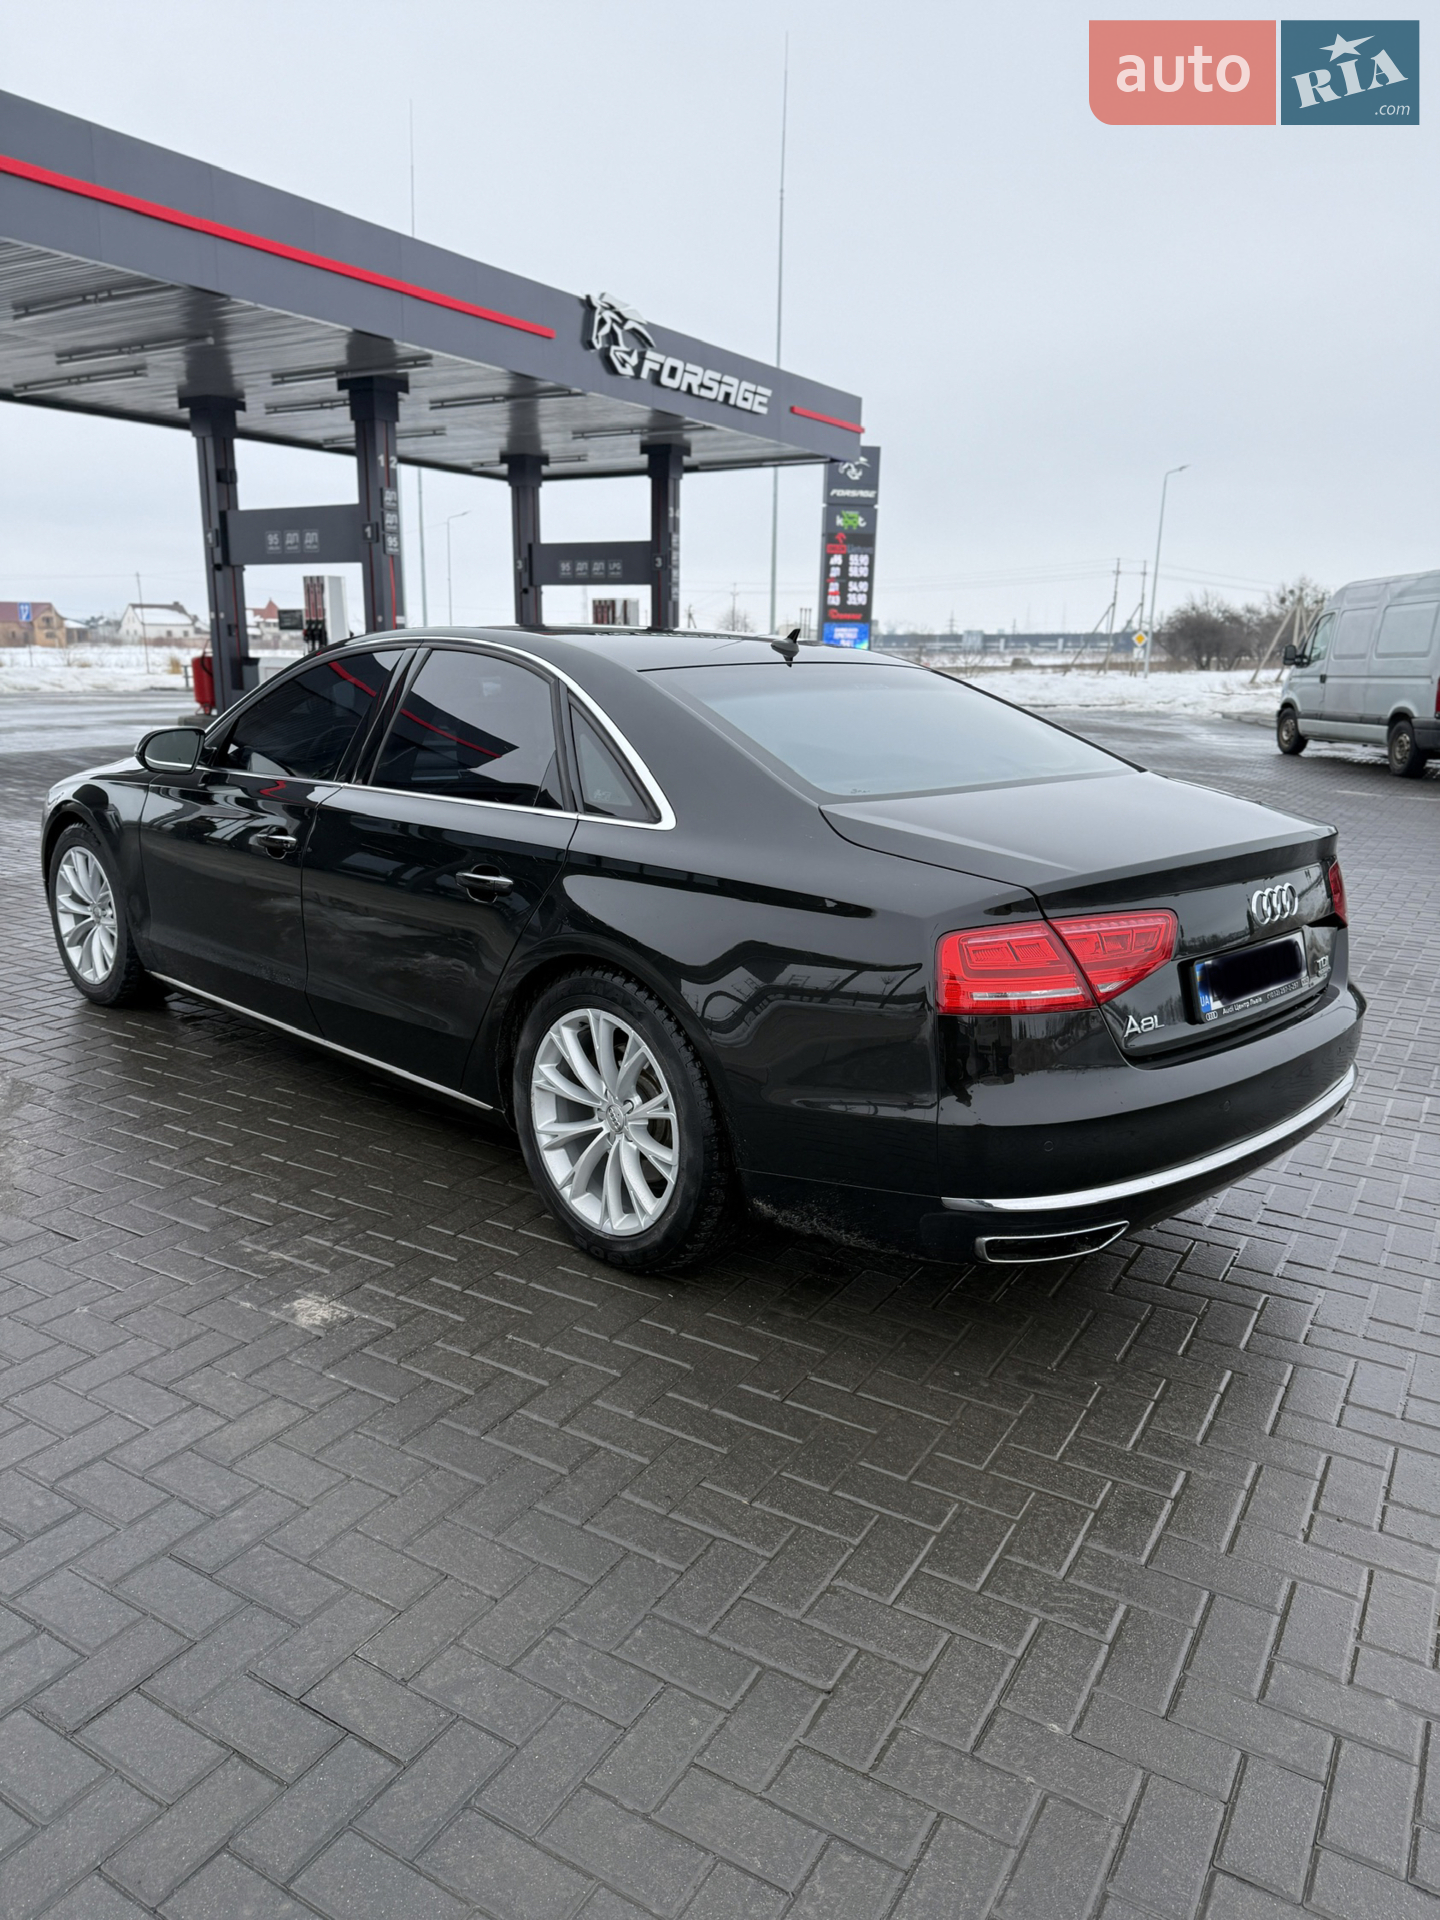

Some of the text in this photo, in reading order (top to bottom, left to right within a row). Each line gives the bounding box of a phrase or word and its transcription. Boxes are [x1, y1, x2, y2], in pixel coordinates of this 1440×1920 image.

[640, 350, 773, 415] FORSAGE
[830, 488, 877, 498] FORSAGE
[364, 526, 372, 538] 1
[267, 533, 279, 545] 95
[386, 536, 398, 547] 95
[516, 561, 523, 569] 3
[560, 562, 571, 571] 95
[608, 562, 621, 570] LPG
[655, 557, 662, 567] 3
[1199, 995, 1211, 1007] UA
[1222, 1004, 1235, 1015] Audi
[1123, 1014, 1165, 1037] A8L
